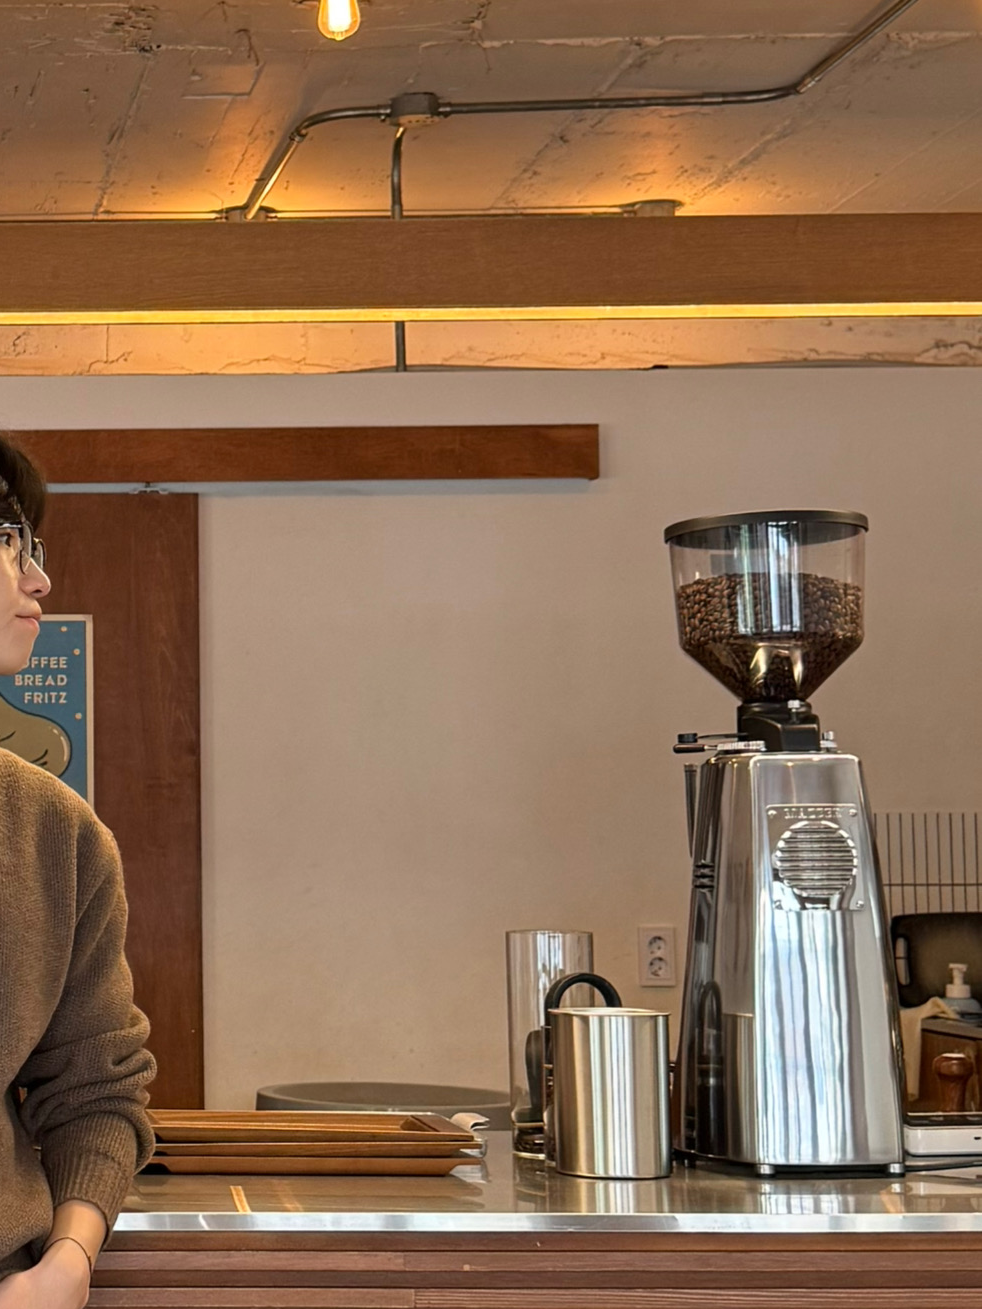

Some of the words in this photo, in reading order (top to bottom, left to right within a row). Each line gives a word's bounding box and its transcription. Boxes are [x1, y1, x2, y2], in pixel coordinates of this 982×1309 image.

[30, 656, 68, 669] FFEE
[14, 674, 68, 687] BREAD
[24, 692, 68, 704] FRITZ
